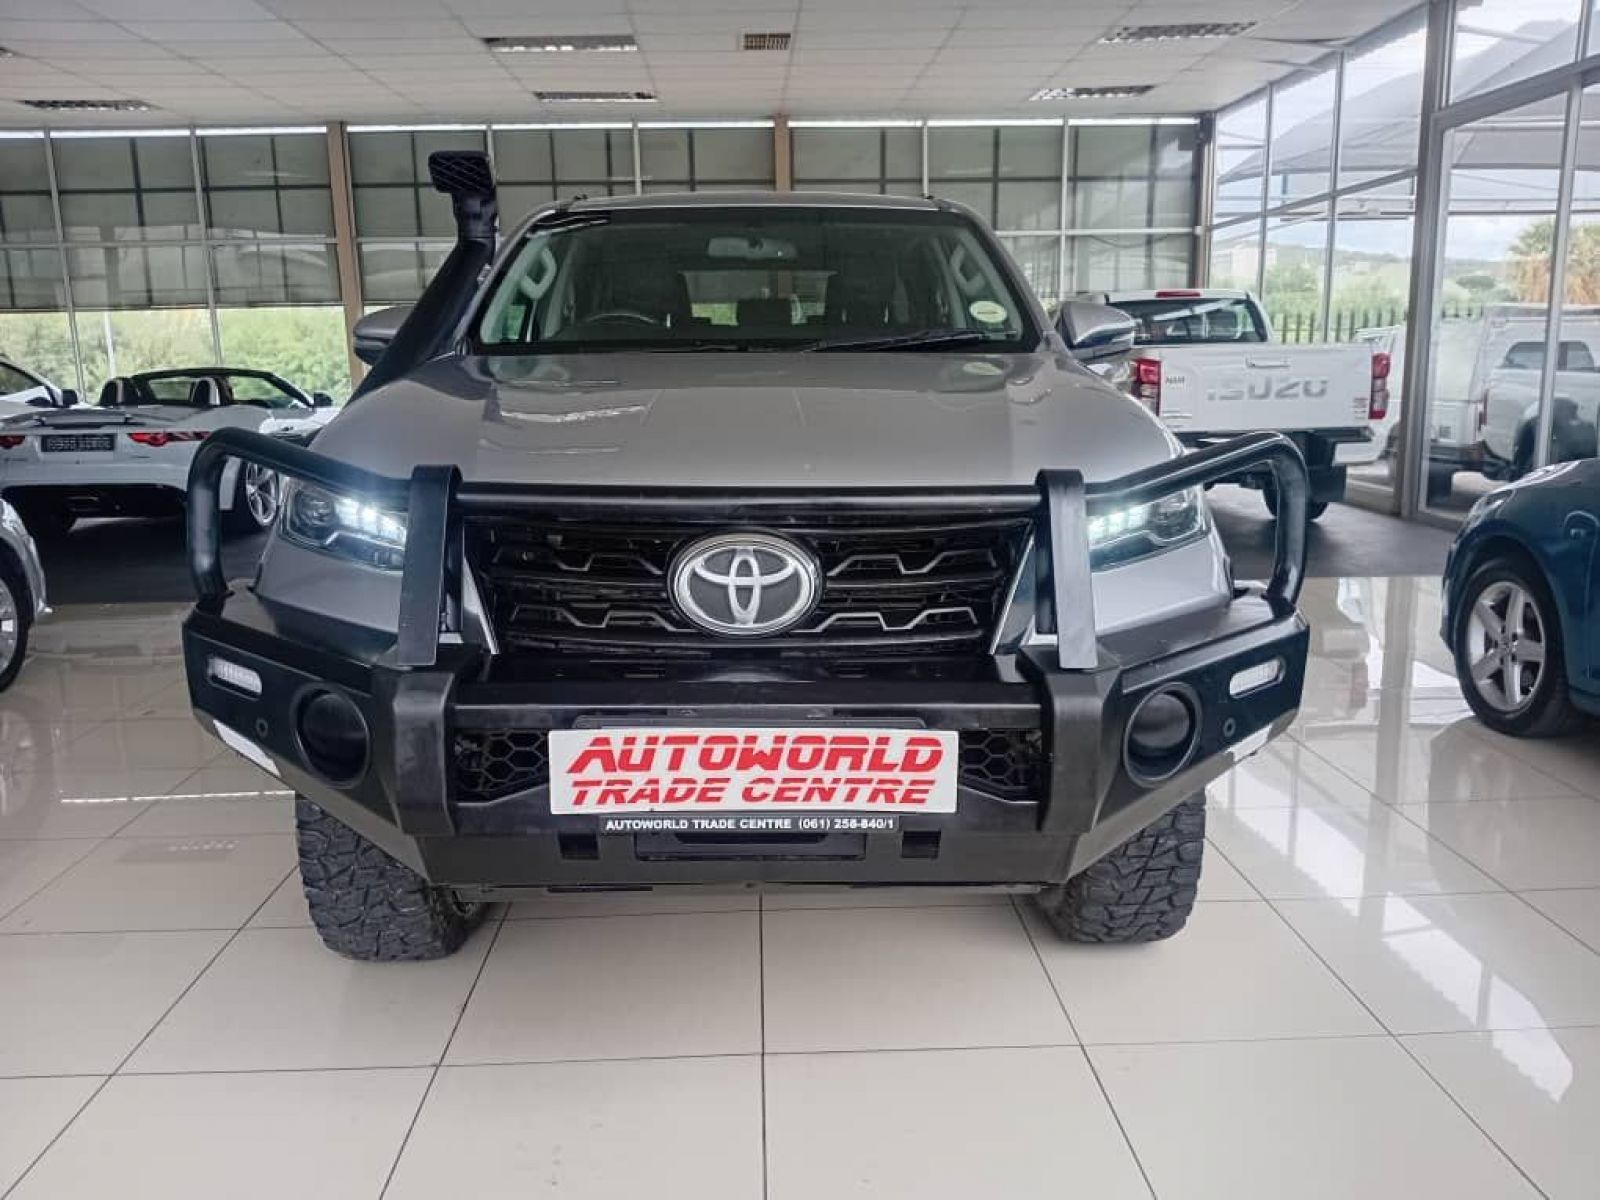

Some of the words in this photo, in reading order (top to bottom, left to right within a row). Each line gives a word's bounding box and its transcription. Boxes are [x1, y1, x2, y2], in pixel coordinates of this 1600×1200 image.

[1206, 375, 1328, 401] ISUZU
[566, 735, 944, 773] AUTOWORLD
[572, 778, 731, 805] TRADE
[742, 778, 936, 804] CENTRE
[605, 819, 688, 830] AUTOWORLD
[692, 819, 737, 829] TRADE
[740, 818, 792, 829] CENTRE
[799, 817, 831, 831] (061)
